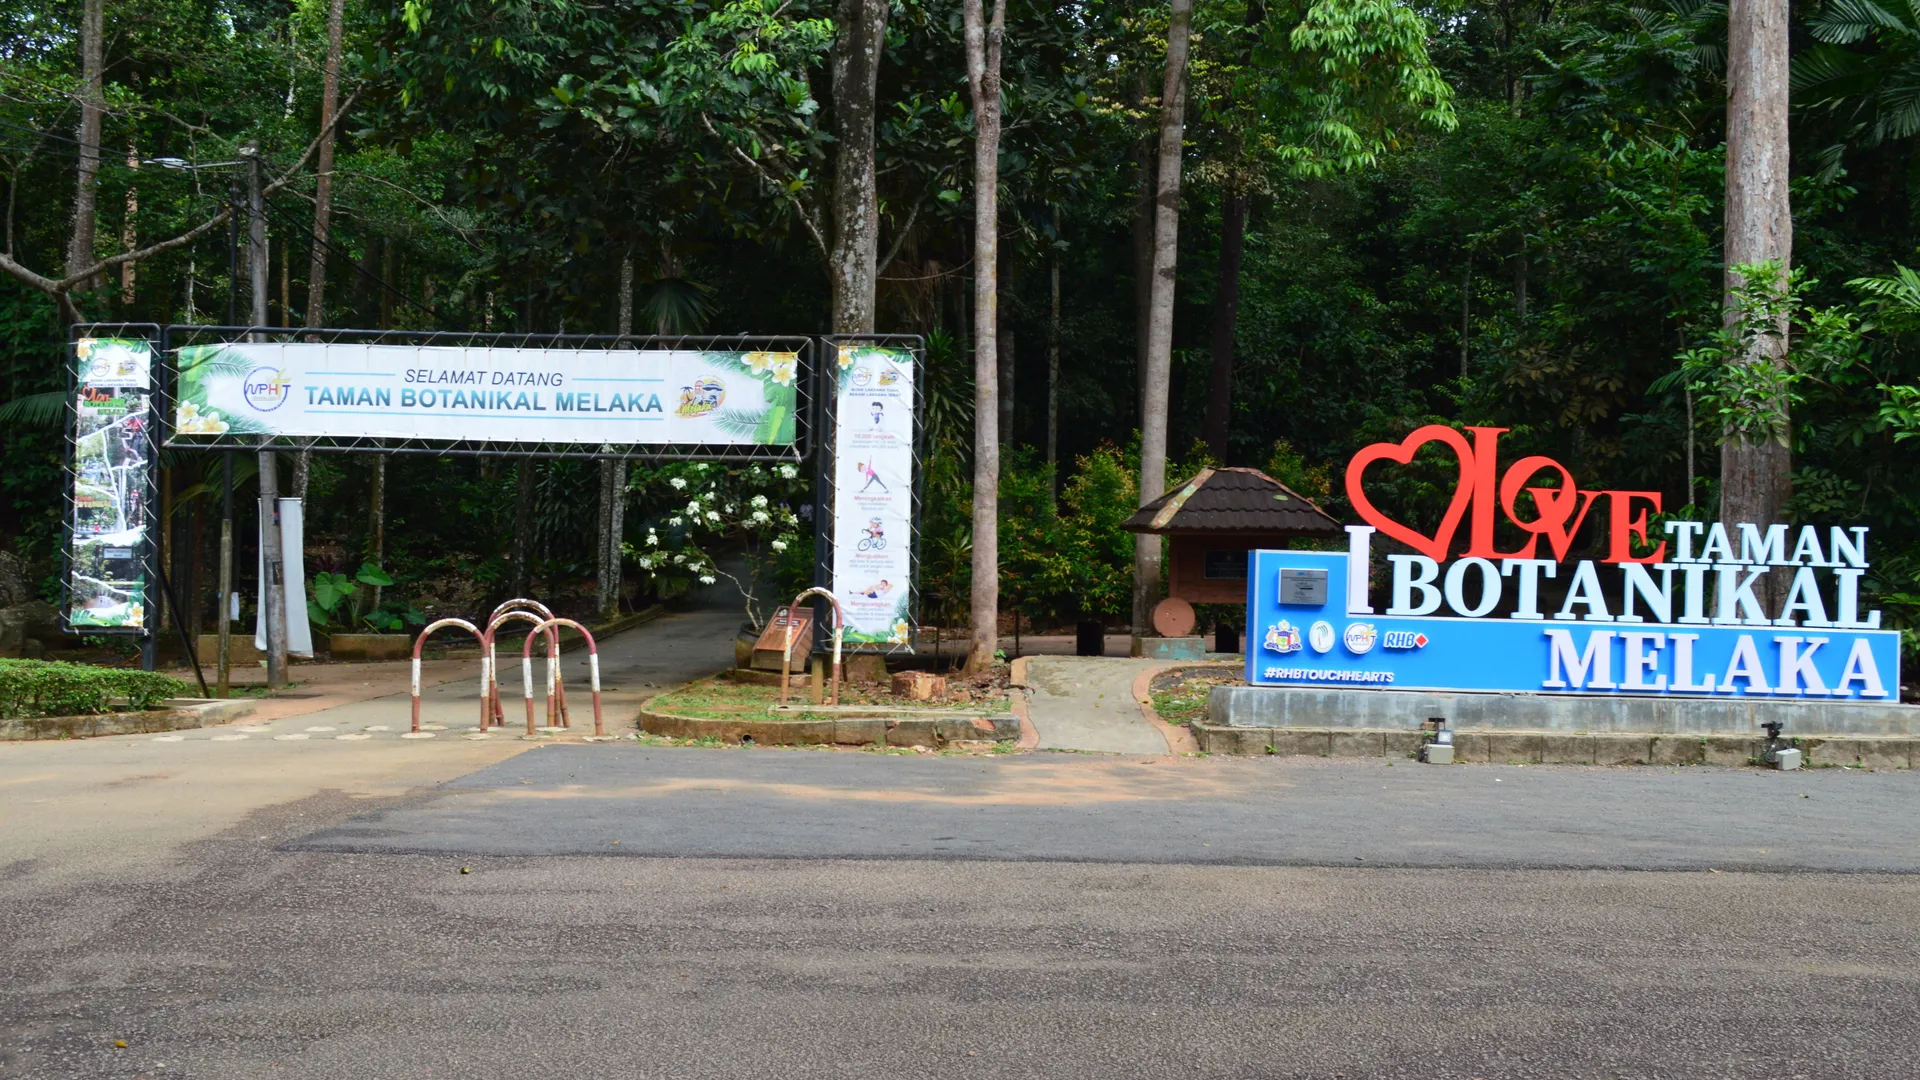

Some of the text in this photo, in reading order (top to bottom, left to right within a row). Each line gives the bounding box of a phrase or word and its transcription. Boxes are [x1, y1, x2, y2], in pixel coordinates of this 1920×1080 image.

[304, 386, 391, 407] TAMAN
[401, 388, 546, 411] BOTANIKAL
[555, 392, 663, 413] MELAKA
[404, 369, 563, 386] SELAMAT DATANG
[1459, 425, 1870, 569] LOVE TAMAN
[1344, 525, 1376, 615] I
[1386, 554, 1881, 629] BOTANIKAL
[1385, 632, 1416, 648] RHB
[1543, 629, 1889, 697] MELAKA
[1264, 667, 1395, 682] #RHBTOUCHHEARTS
